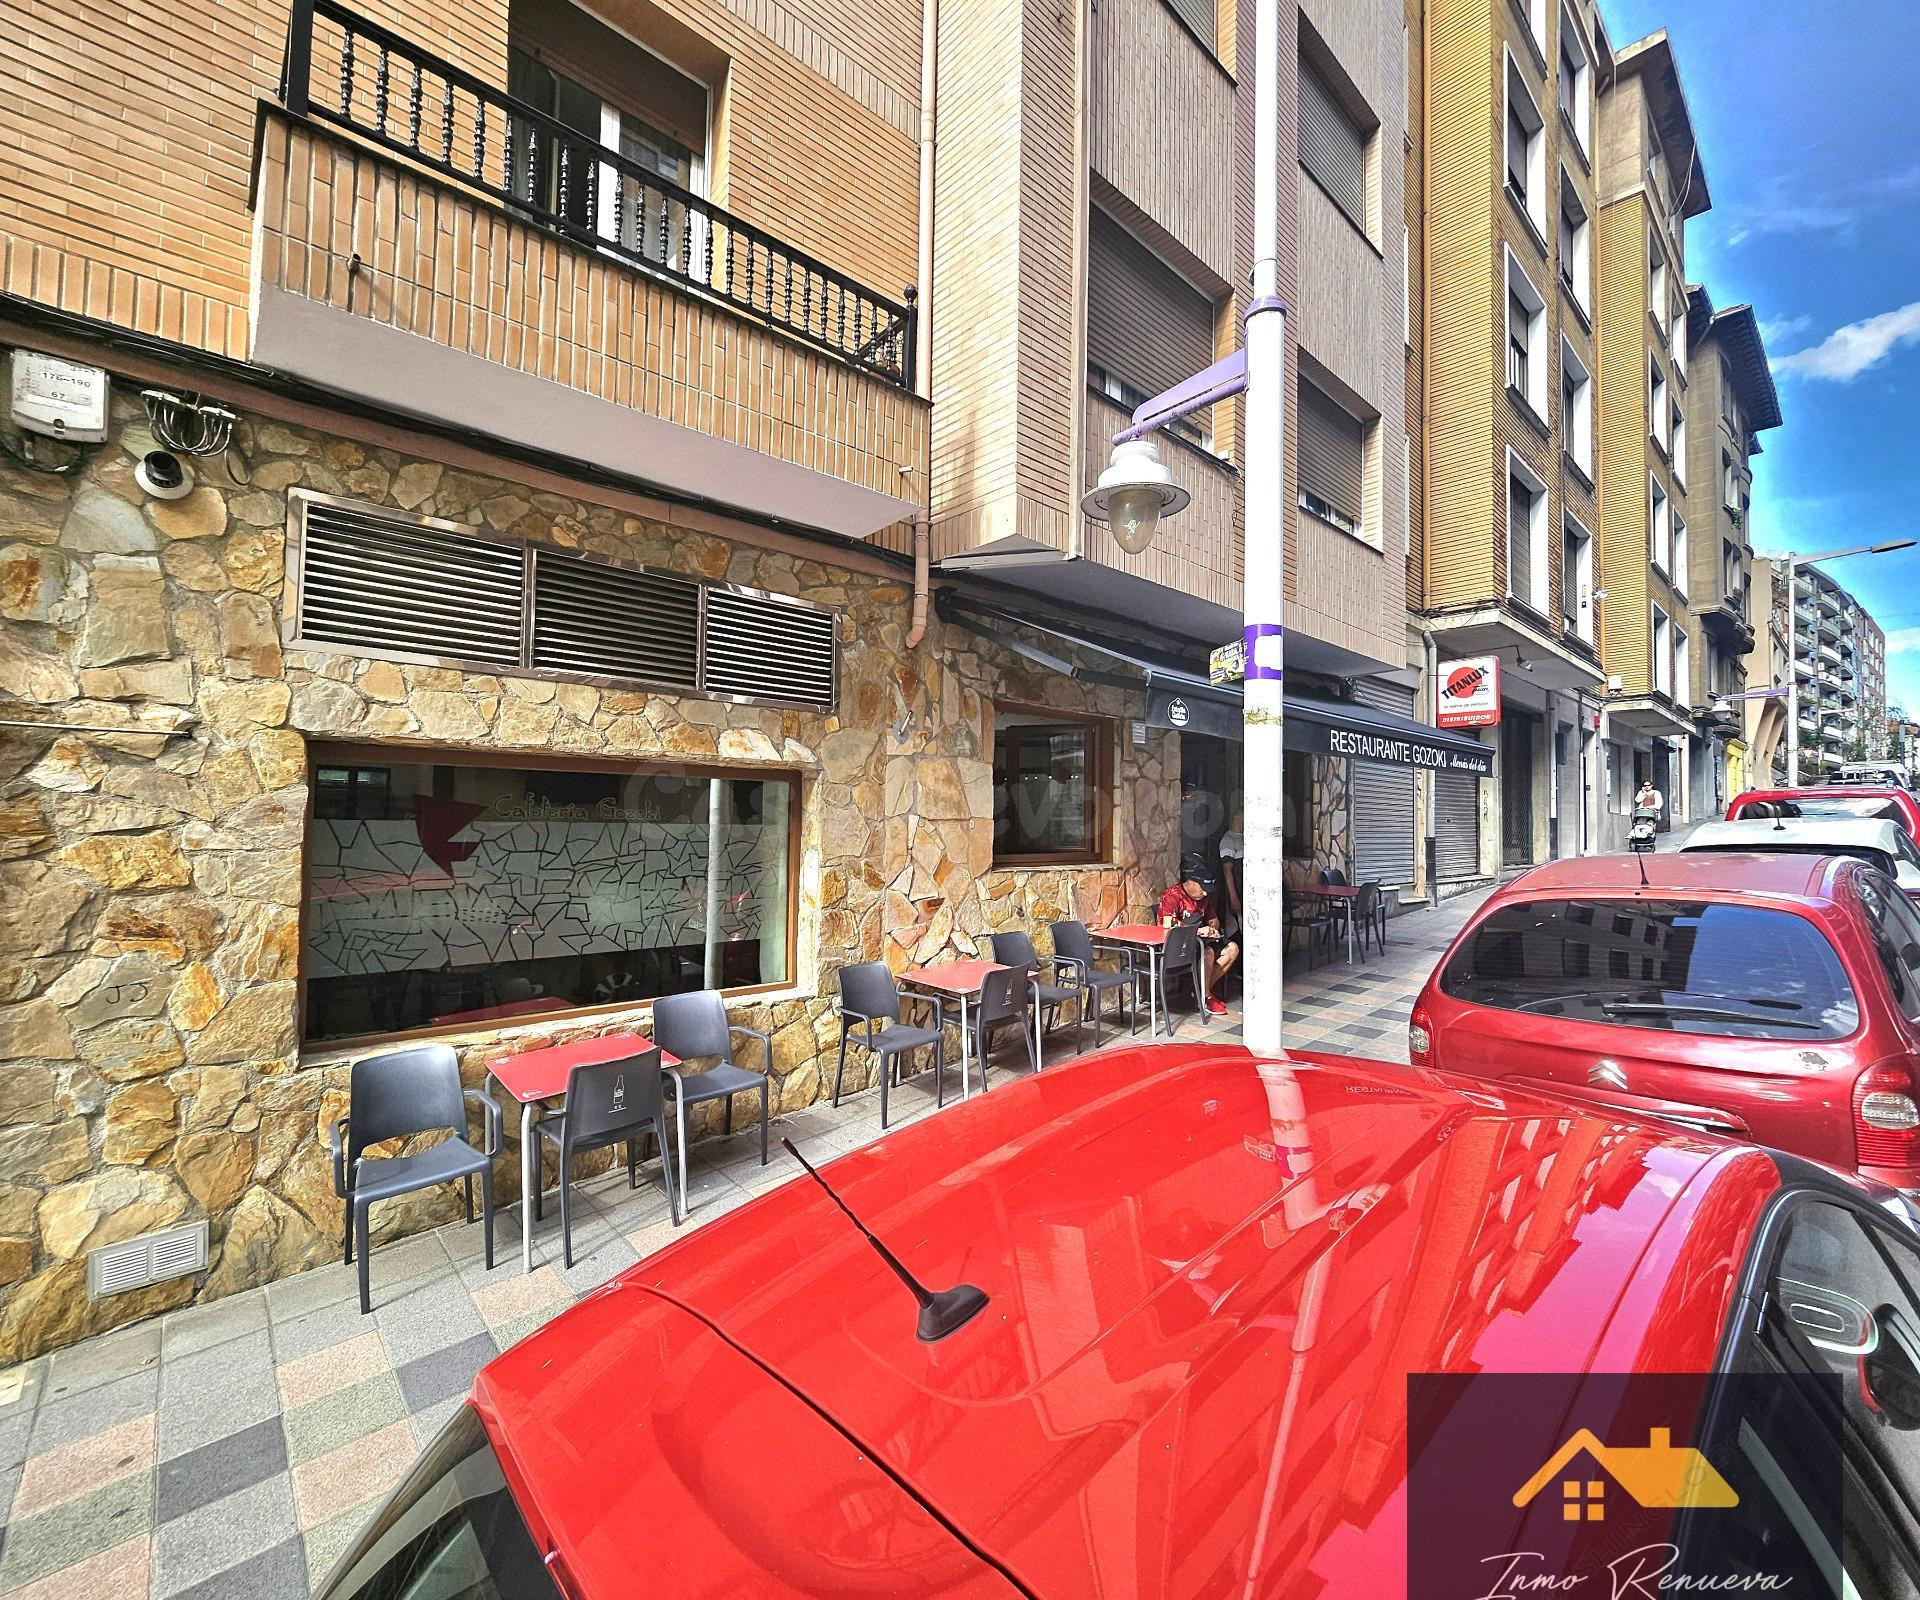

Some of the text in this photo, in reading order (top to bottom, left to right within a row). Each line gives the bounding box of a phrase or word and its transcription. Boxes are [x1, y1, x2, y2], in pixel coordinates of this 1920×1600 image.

[1441, 665, 1490, 700] TITANLUX
[1330, 729, 1411, 763] RESTAURANTE
[1412, 745, 1447, 768] GOZOKI
